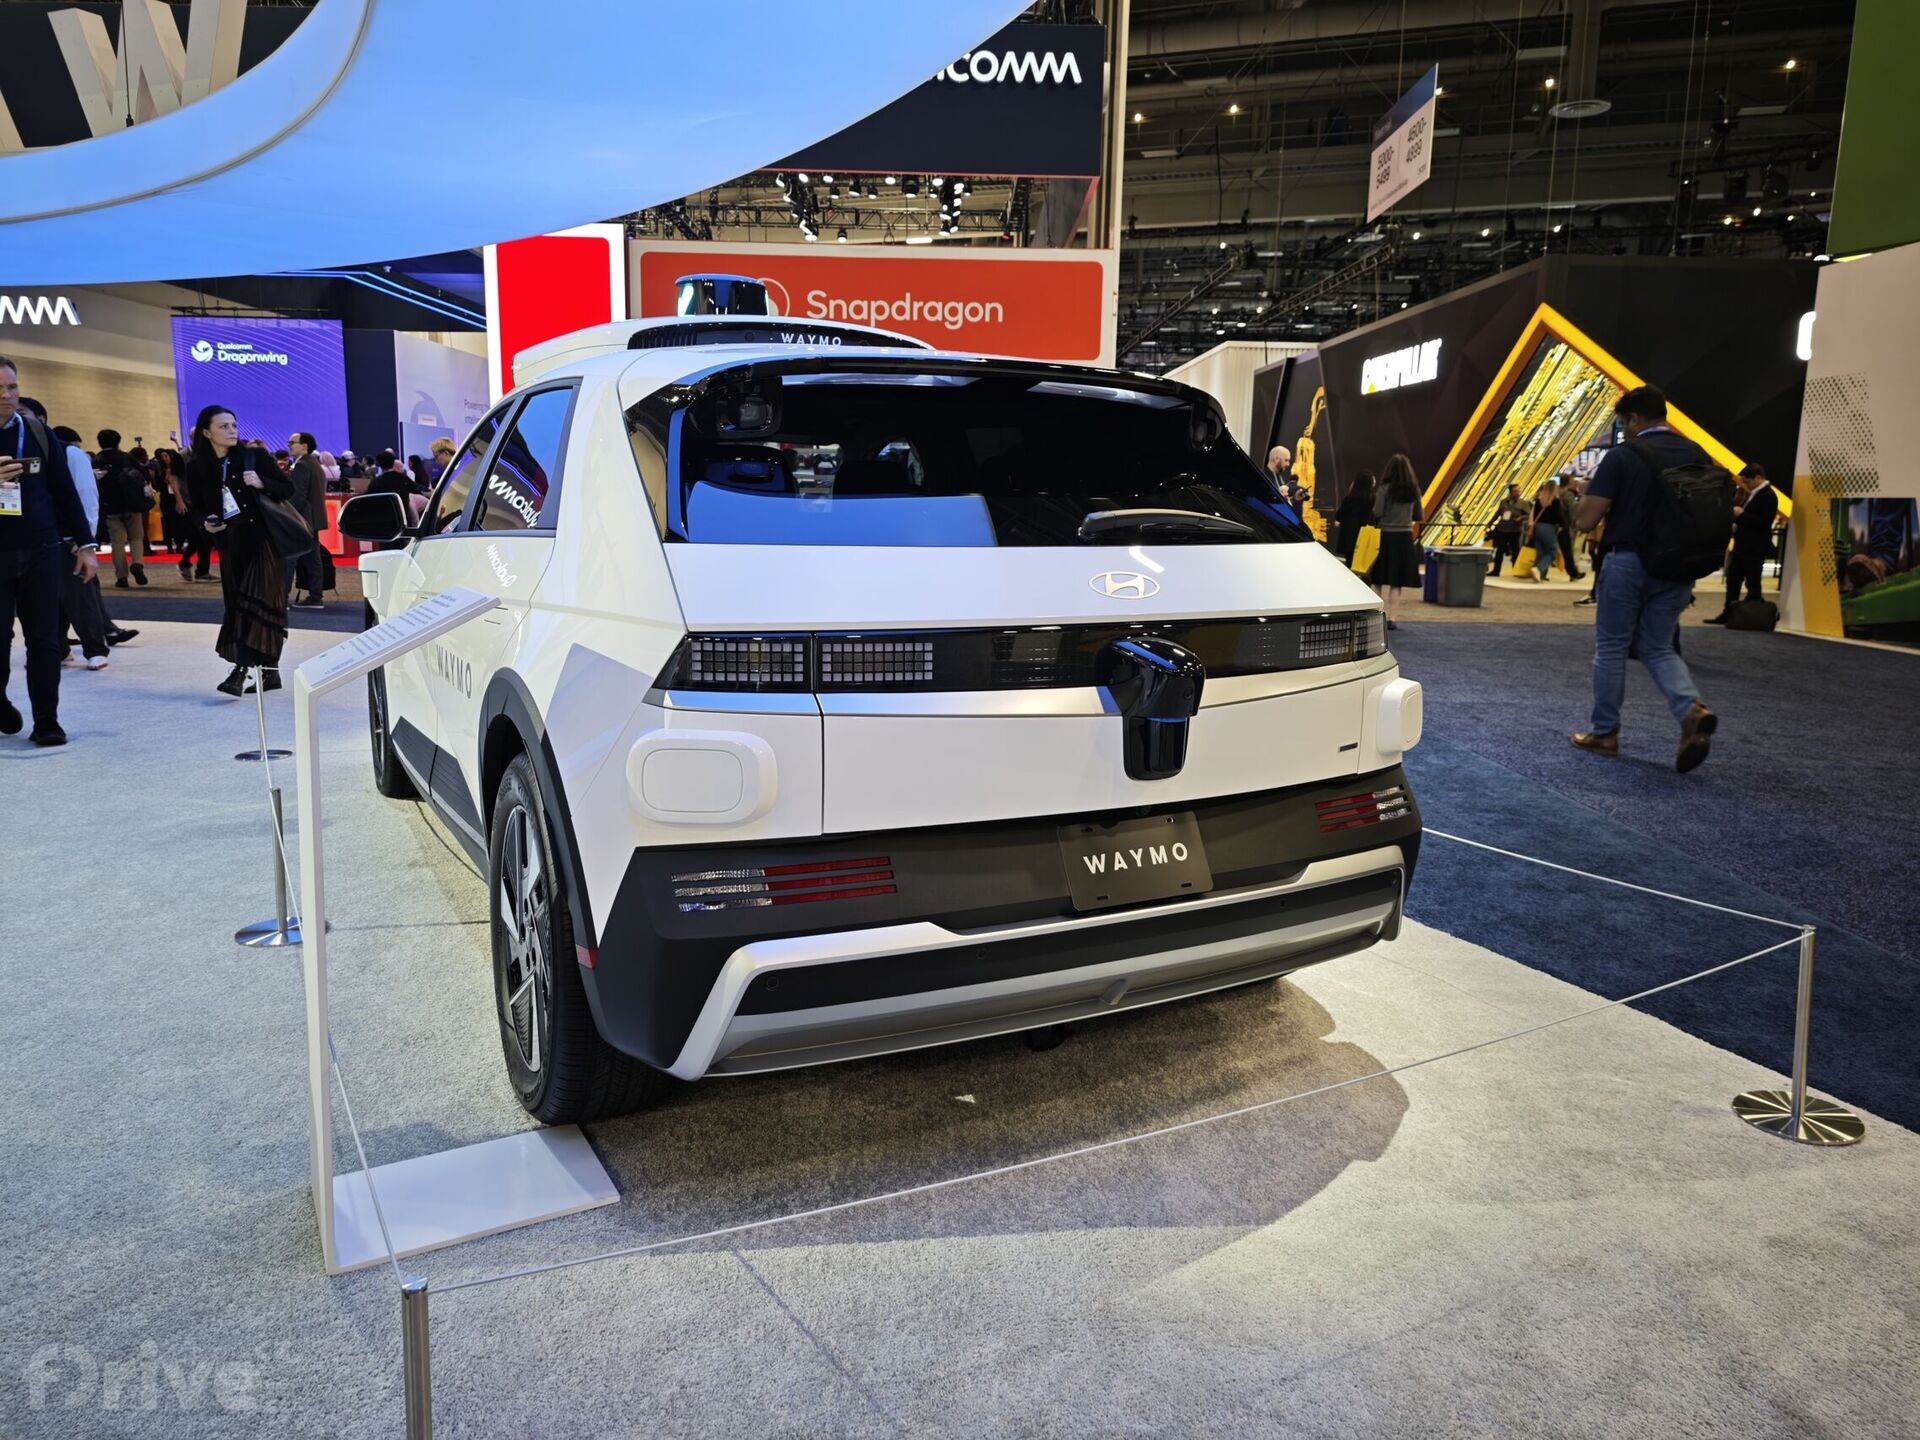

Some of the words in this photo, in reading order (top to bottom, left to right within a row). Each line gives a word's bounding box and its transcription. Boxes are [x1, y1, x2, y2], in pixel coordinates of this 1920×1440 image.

[806, 289, 1004, 330] Snapdragon
[217, 342, 253, 350] Qualcomm
[781, 332, 842, 346] WAYMO
[218, 350, 288, 366] Dragonwing
[436, 643, 472, 699] WAYMO
[1083, 842, 1188, 874] WAYMO
